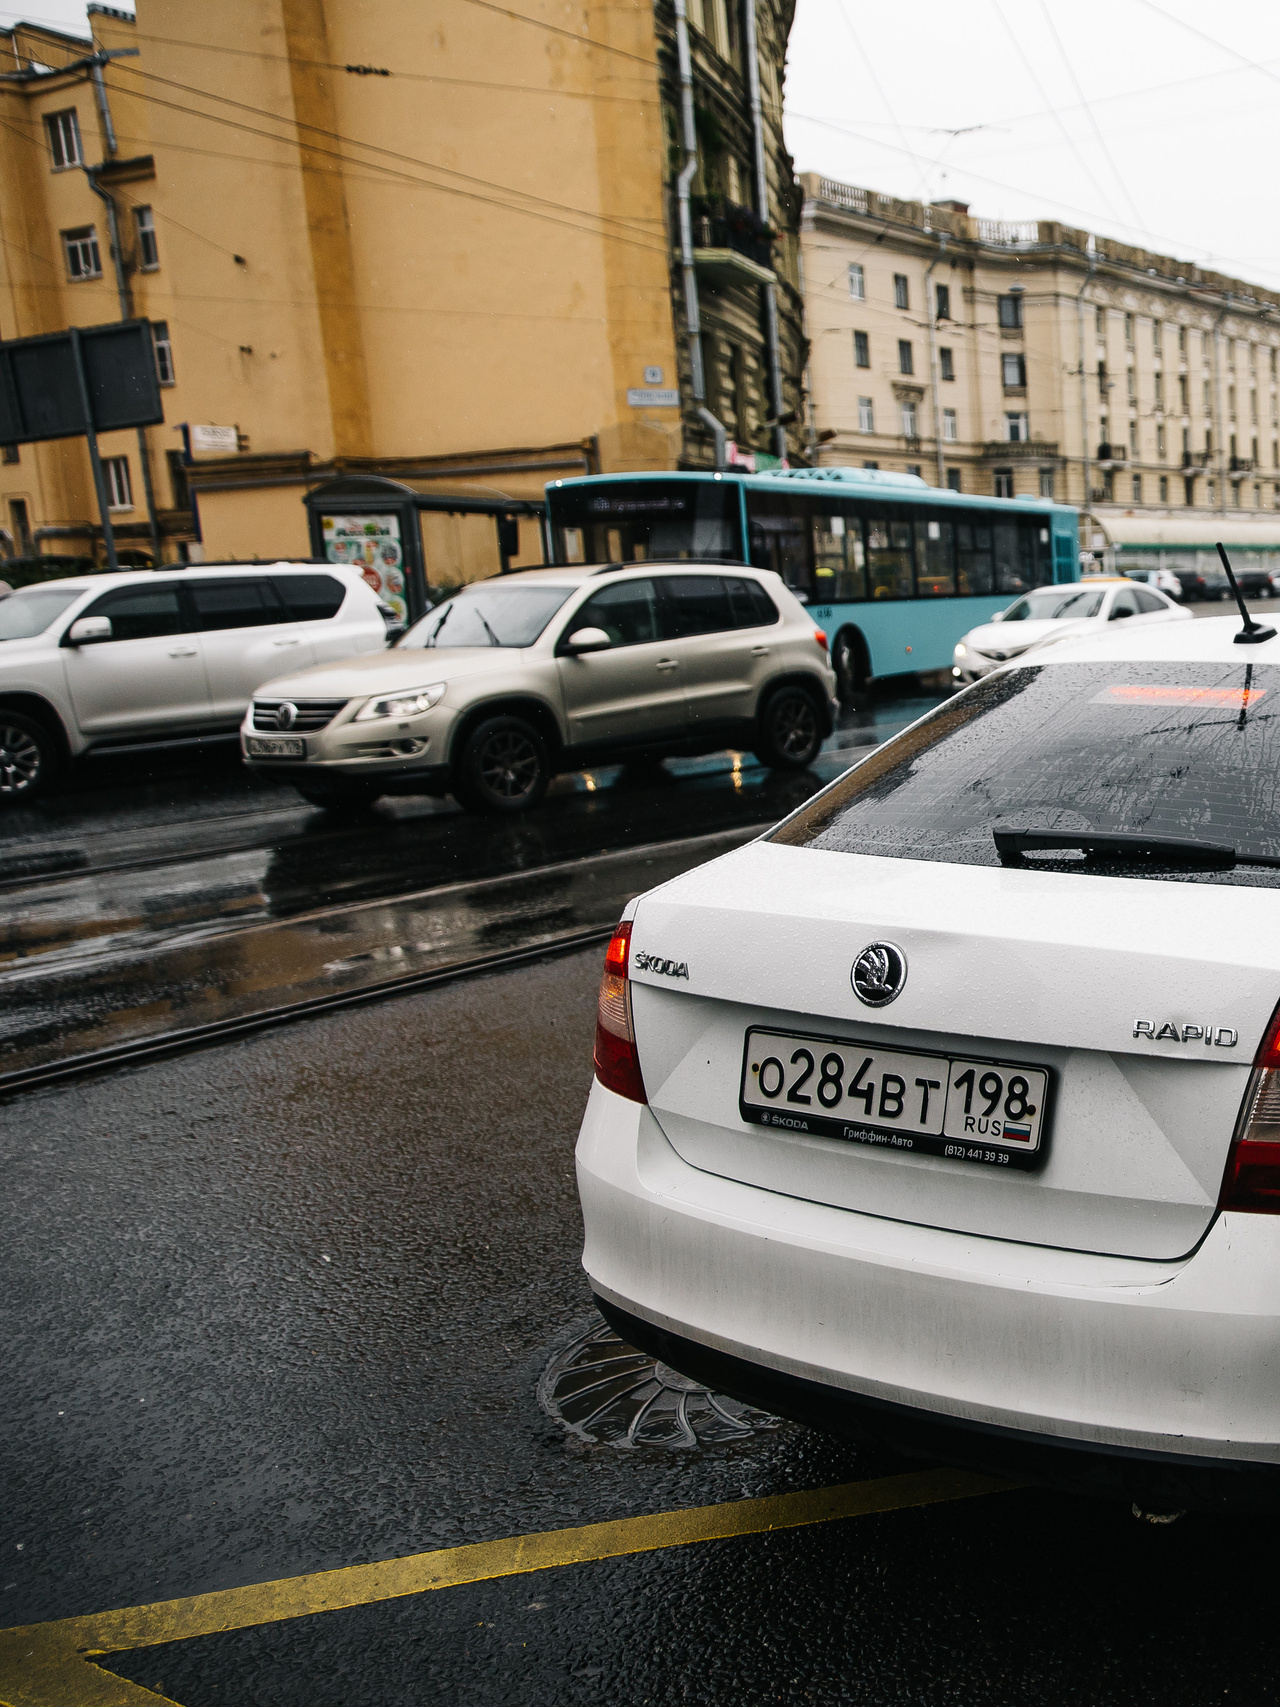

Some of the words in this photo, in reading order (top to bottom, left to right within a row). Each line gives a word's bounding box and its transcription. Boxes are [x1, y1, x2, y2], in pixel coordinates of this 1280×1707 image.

[634, 949, 690, 980] ŠKODA
[1132, 1019, 1239, 1048] RAPID
[953, 1068, 1030, 1121] 198
[771, 1114, 809, 1131] ŠKODA
[964, 1115, 1002, 1137] RUS
[843, 1125, 914, 1149] Гриффин-Авто
[944, 1144, 966, 1159] (812)
[966, 1149, 983, 1160] 441
[983, 1151, 996, 1162] 39
[997, 1153, 1010, 1164] 39
